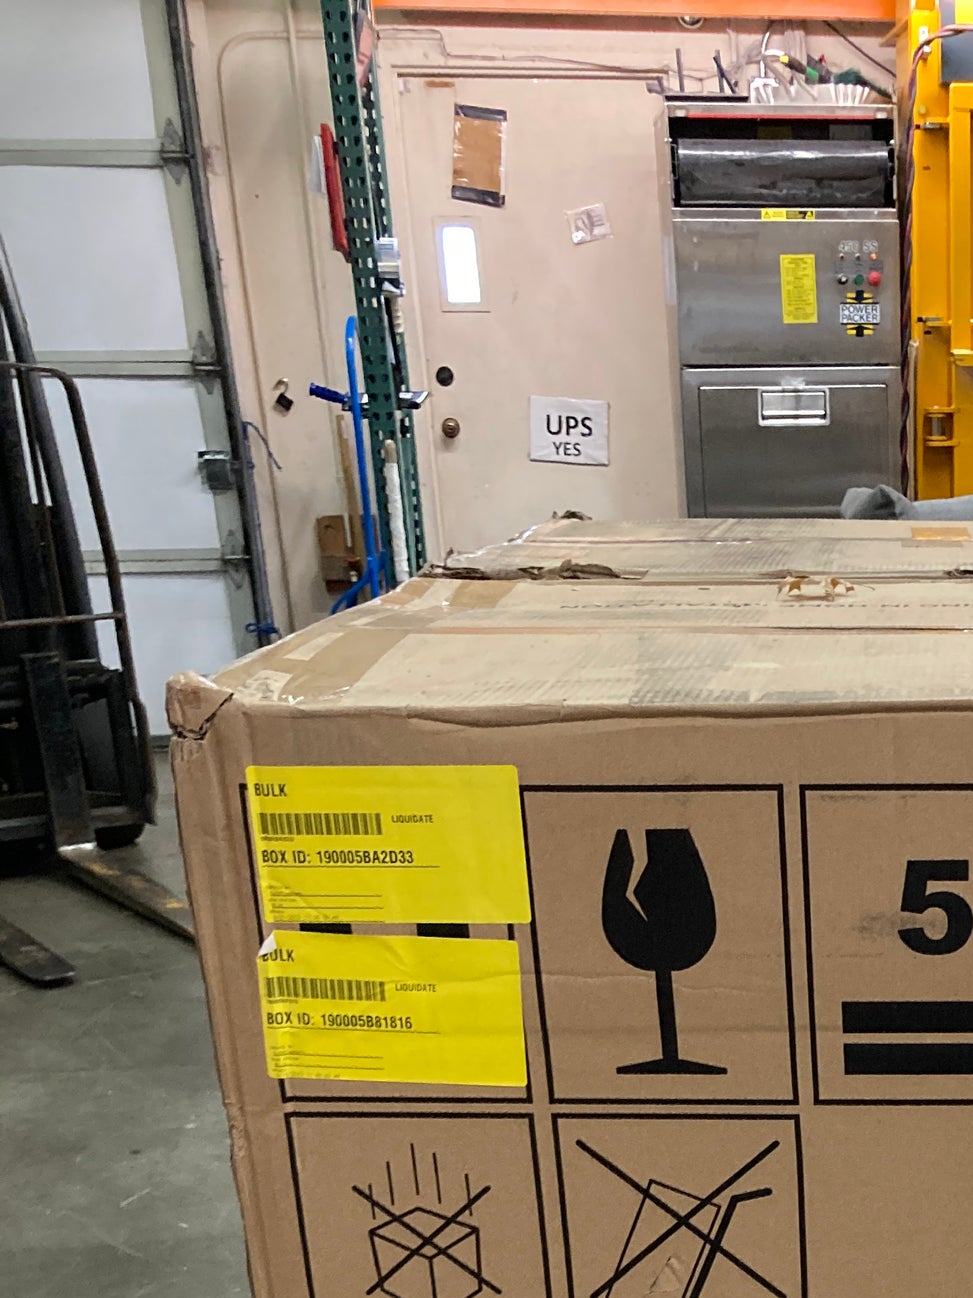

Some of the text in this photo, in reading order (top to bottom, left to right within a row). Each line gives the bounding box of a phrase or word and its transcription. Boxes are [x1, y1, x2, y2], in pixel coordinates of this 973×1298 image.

[841, 305, 878, 314] POWER
[841, 314, 878, 322] PACKER
[546, 414, 593, 437] UPS
[552, 441, 582, 457] YES
[253, 783, 287, 797] BULK
[391, 814, 433, 824] LIQUIDATE
[262, 850, 414, 865] BOX ID: 190005BA2D33
[897, 860, 973, 956] 5
[395, 983, 437, 993] LIQUIDATE
[267, 1011, 292, 1026] BOX
[297, 1012, 315, 1027] ID:
